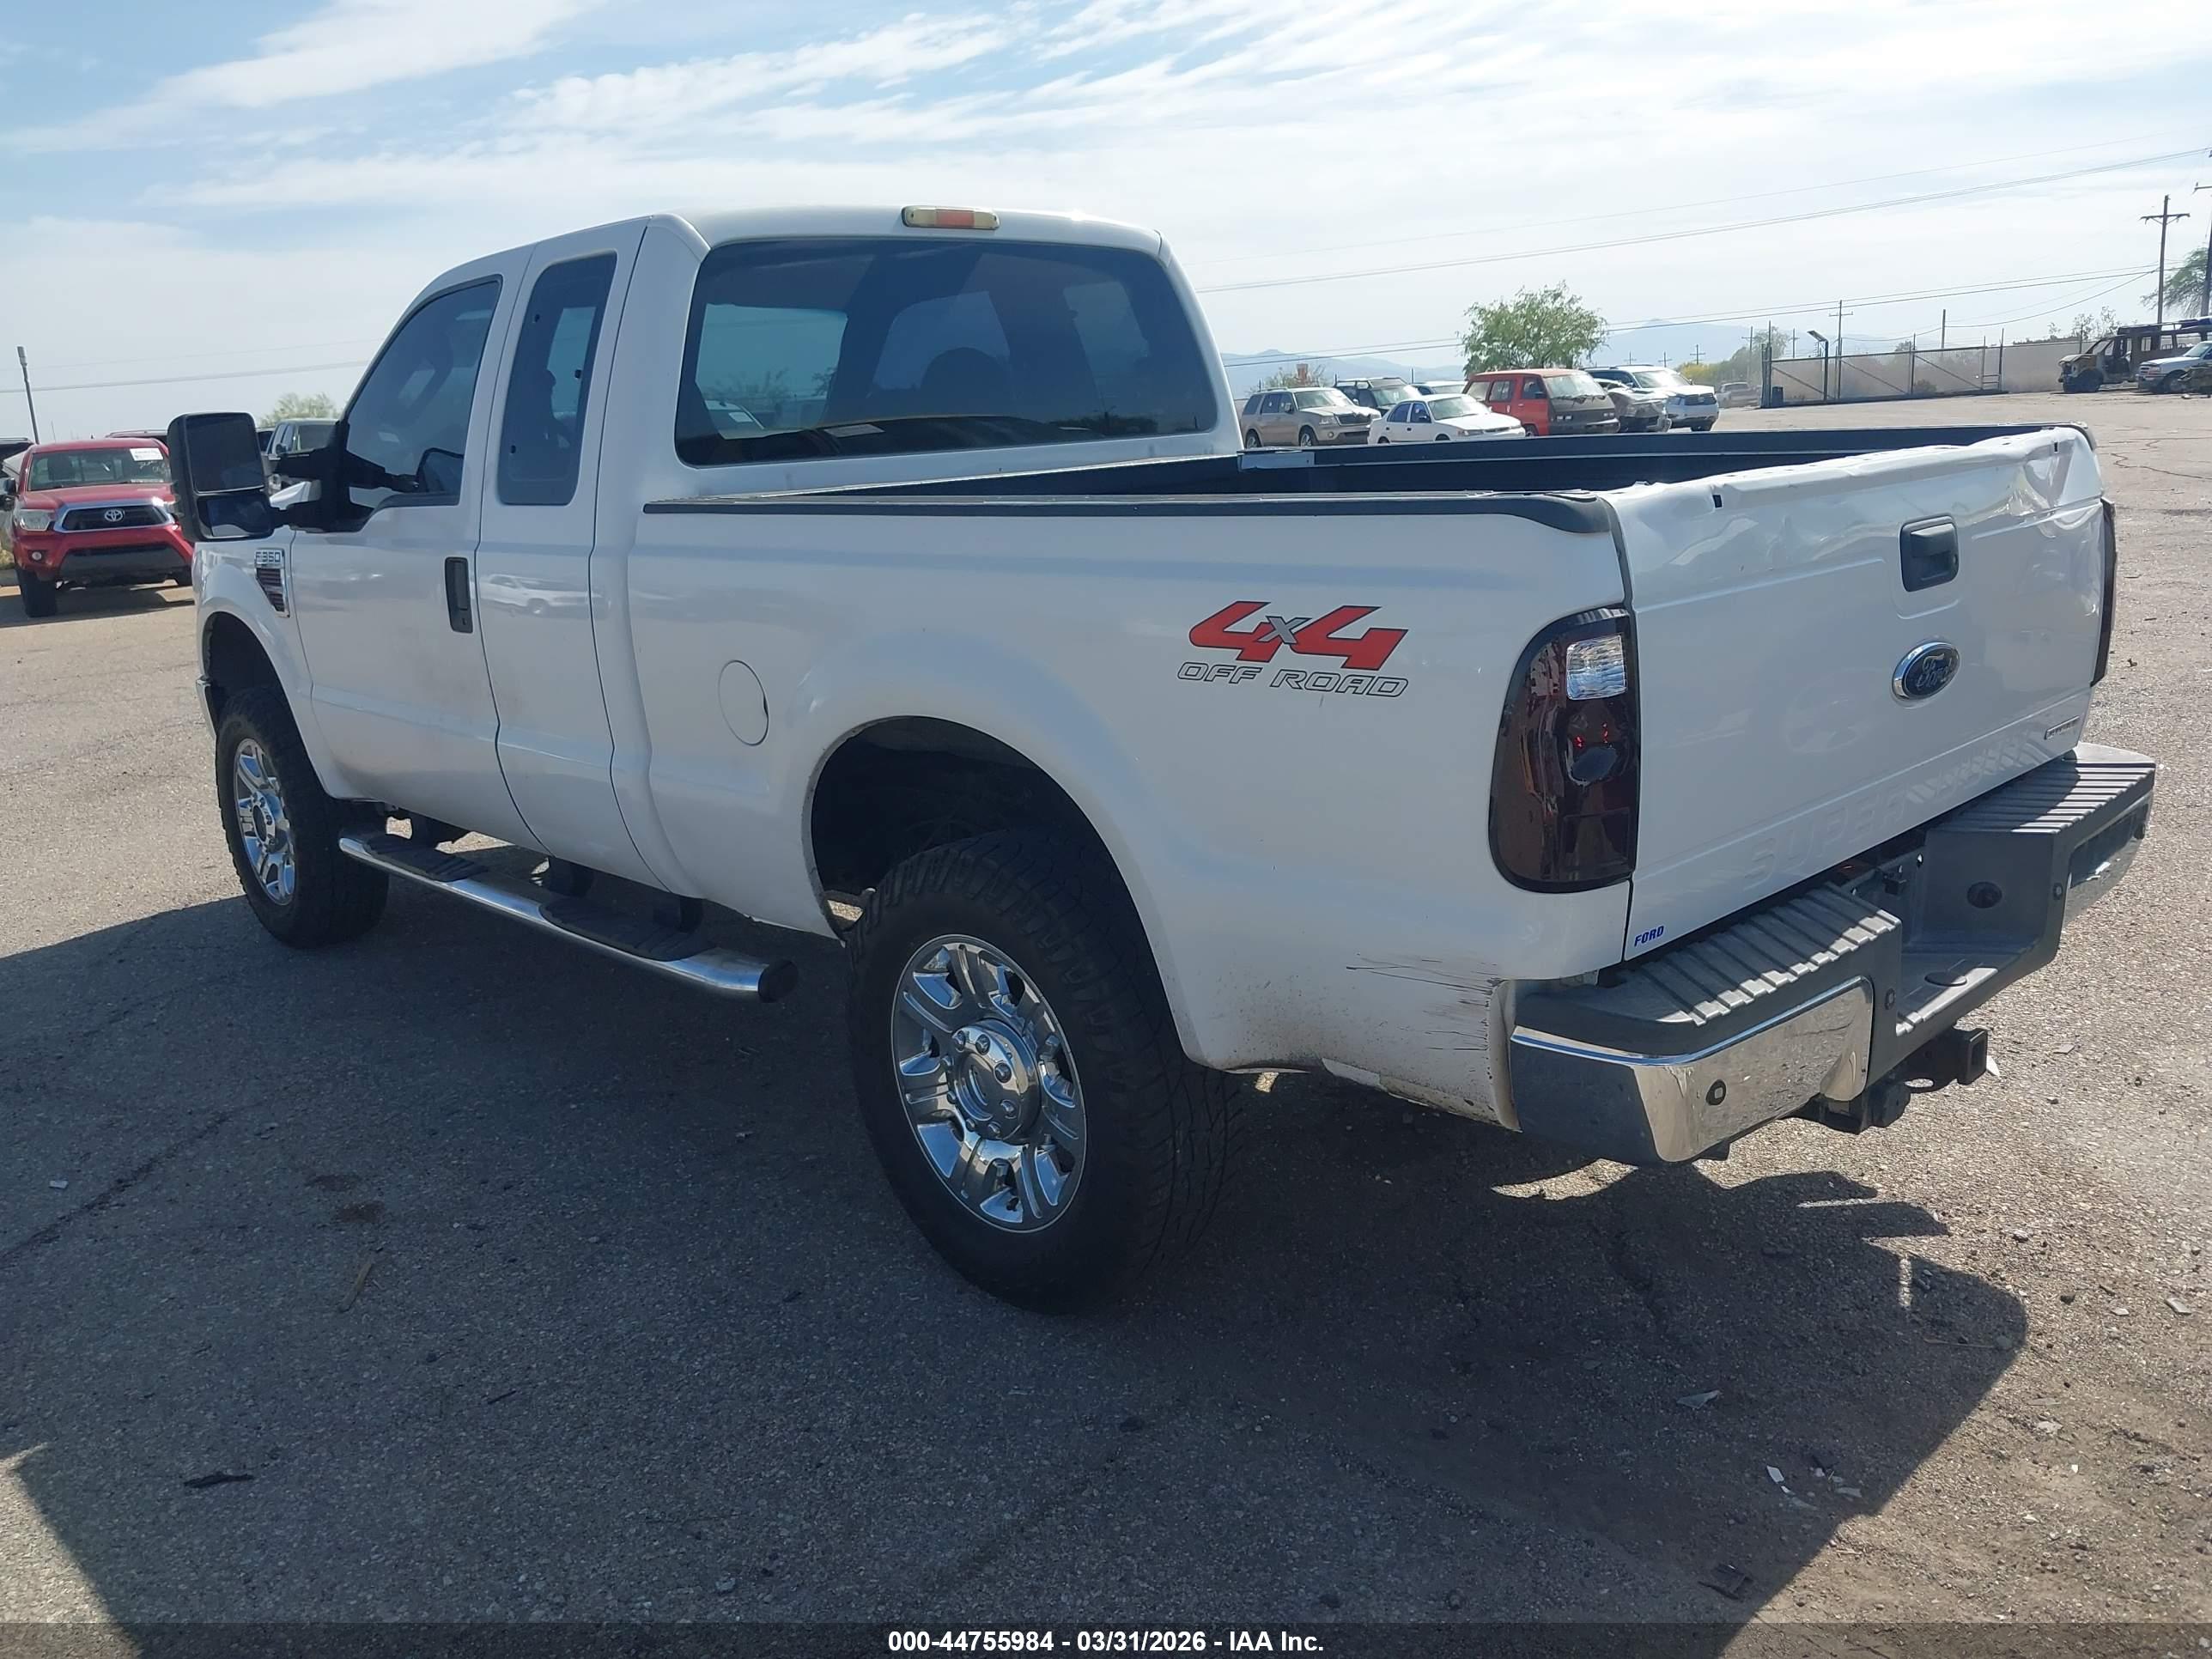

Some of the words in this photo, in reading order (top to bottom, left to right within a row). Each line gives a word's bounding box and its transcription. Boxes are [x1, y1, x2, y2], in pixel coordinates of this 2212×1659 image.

[1177, 661, 1263, 684] OFF
[1269, 669, 1409, 698] ROAD
[1634, 925, 1664, 947] FORD
